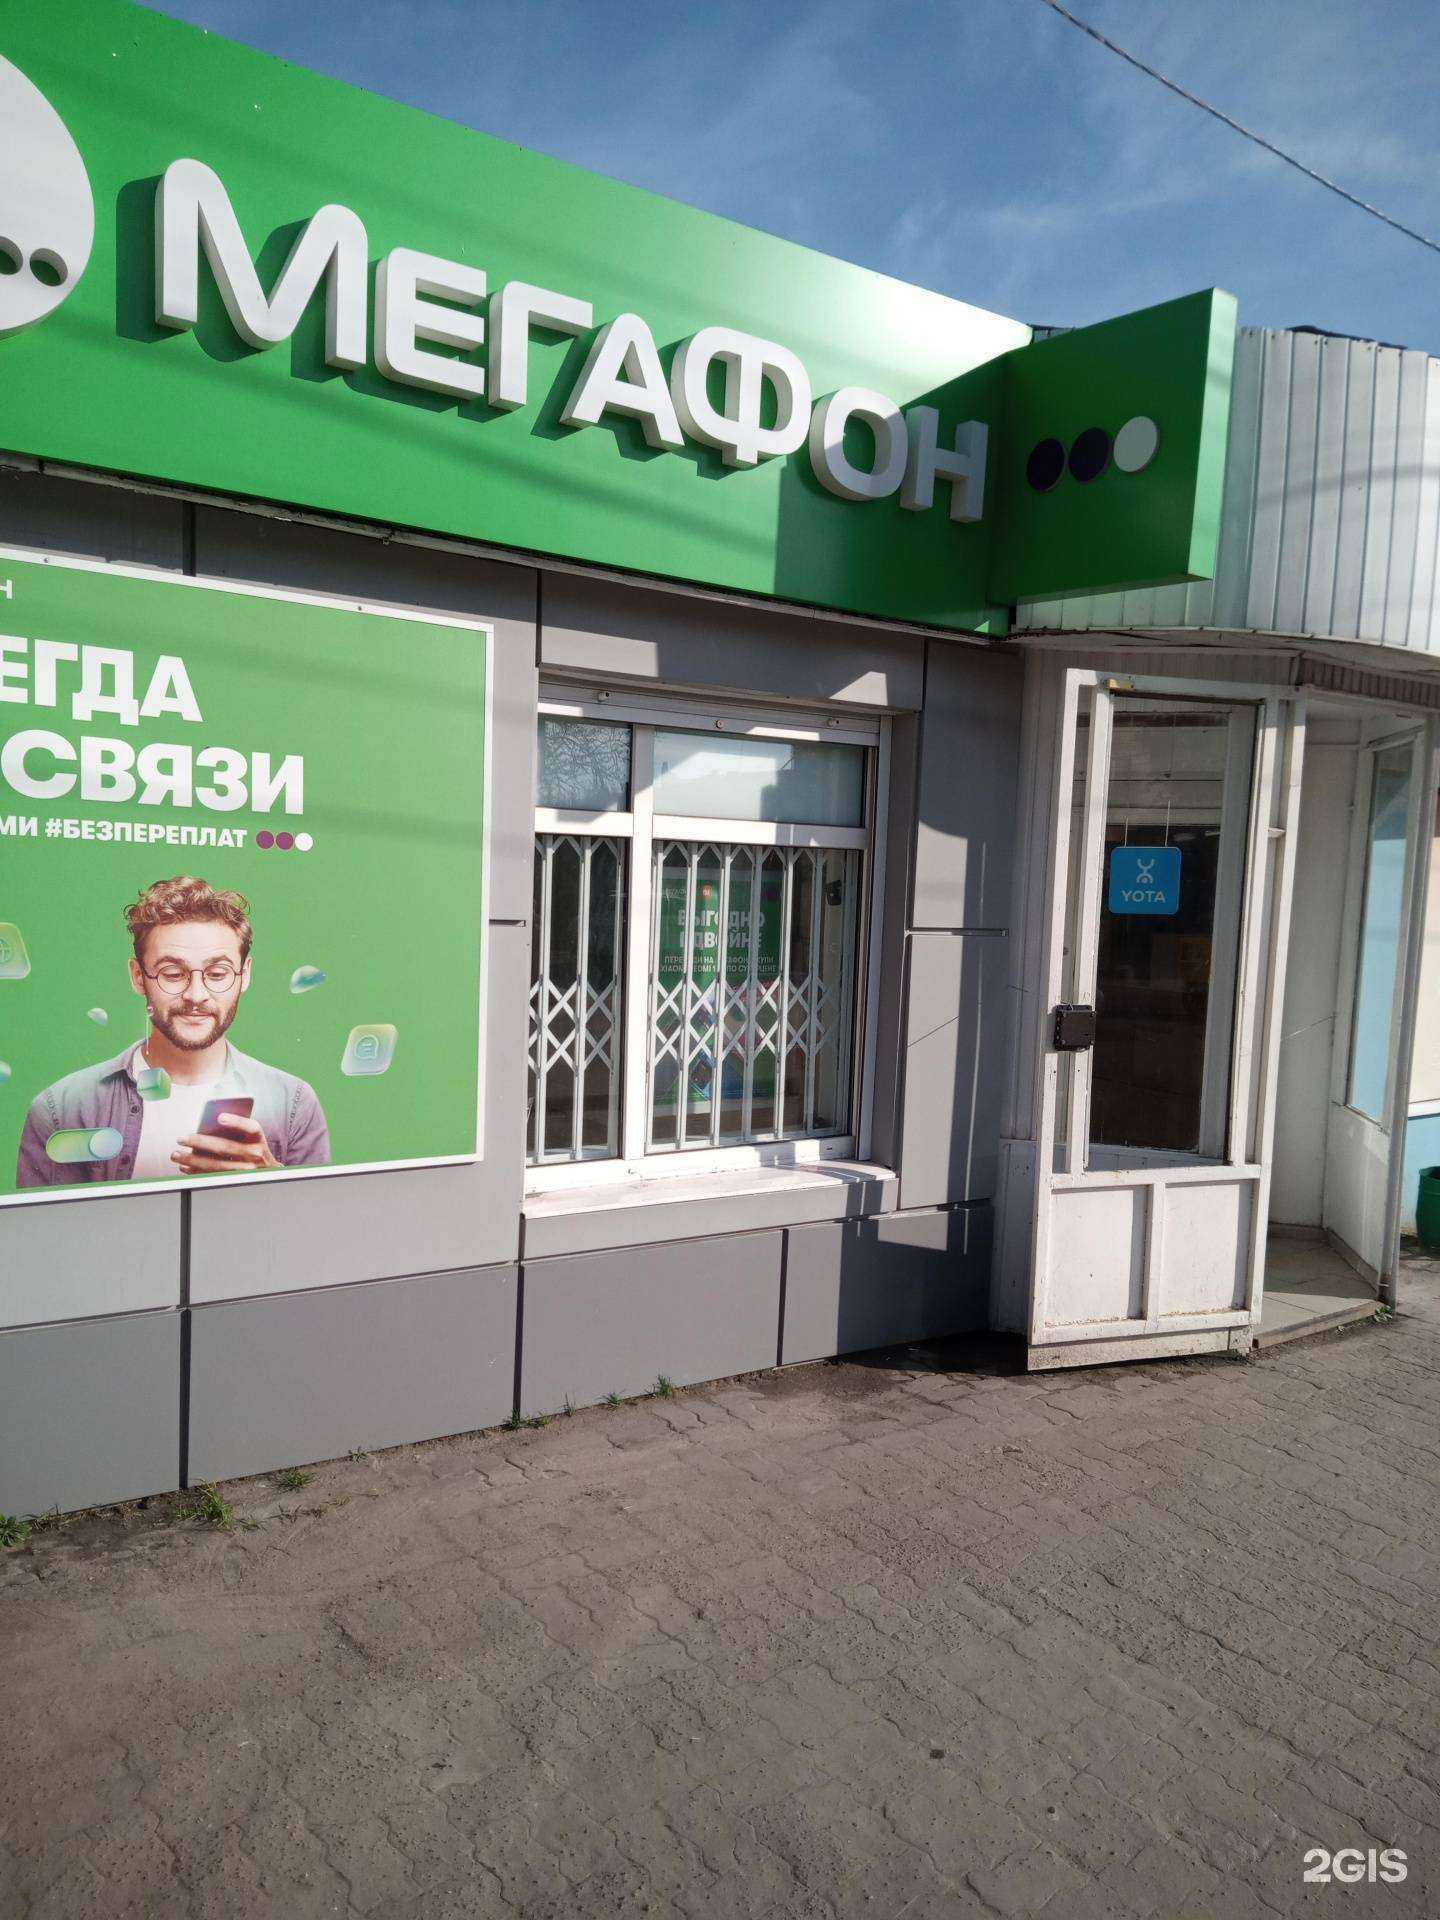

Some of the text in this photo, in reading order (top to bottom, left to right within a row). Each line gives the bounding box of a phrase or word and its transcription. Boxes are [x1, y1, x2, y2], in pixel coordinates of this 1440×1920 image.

[155, 158, 989, 523] МЕГАФОН
[0, 635, 204, 726] ЕГДА
[0, 729, 304, 815] СВЯЗИ
[45, 818, 247, 848] #БЕЗПЕРЕПЛАТ
[1121, 889, 1166, 904] YOTA
